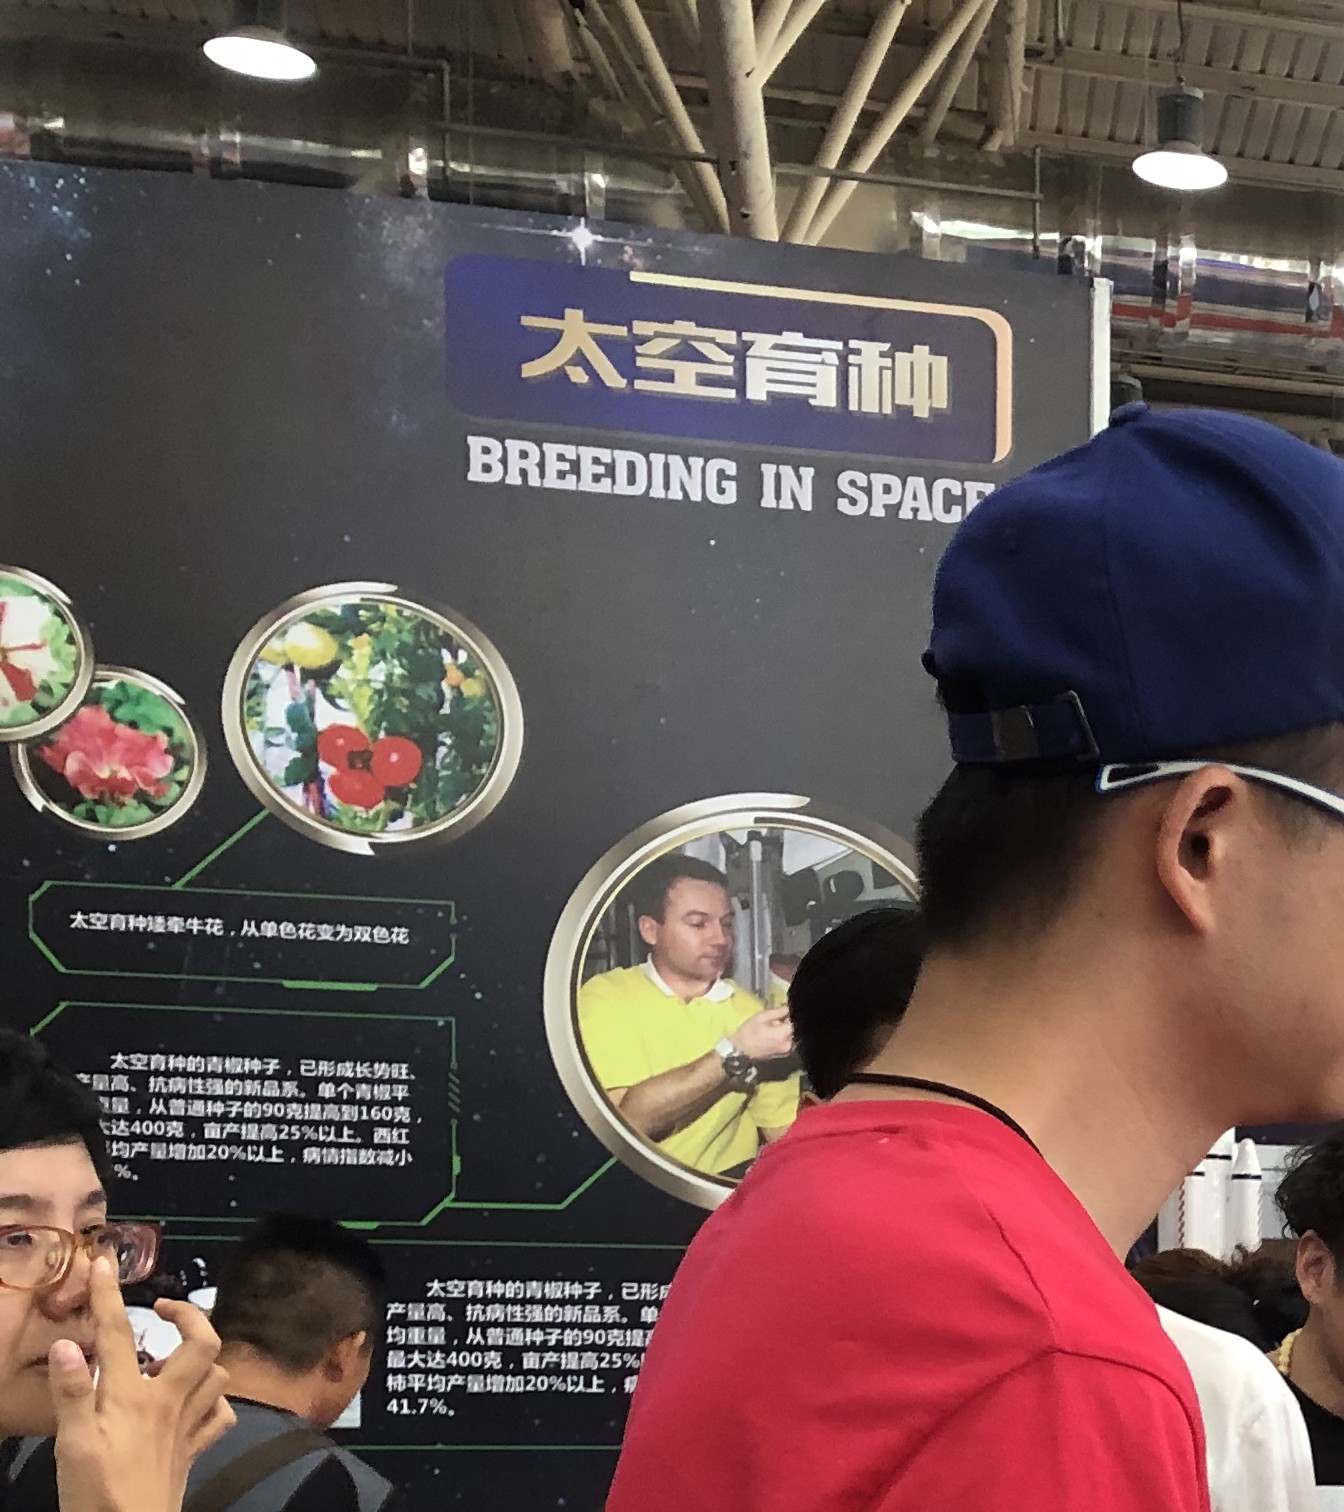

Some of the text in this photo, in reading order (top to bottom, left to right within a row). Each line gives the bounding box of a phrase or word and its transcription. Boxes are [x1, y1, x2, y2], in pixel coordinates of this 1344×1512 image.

[520, 307, 949, 419] 太空育种
[466, 435, 738, 506] BREEDING
[760, 463, 815, 512] IN
[105, 1140, 413, 1166] 均产量增加20%以上，病情指数减小
[386, 1326, 654, 1348] 均重量，从普通种子的90克提
[386, 1350, 645, 1370] 最大达400克，亩产提高25%
